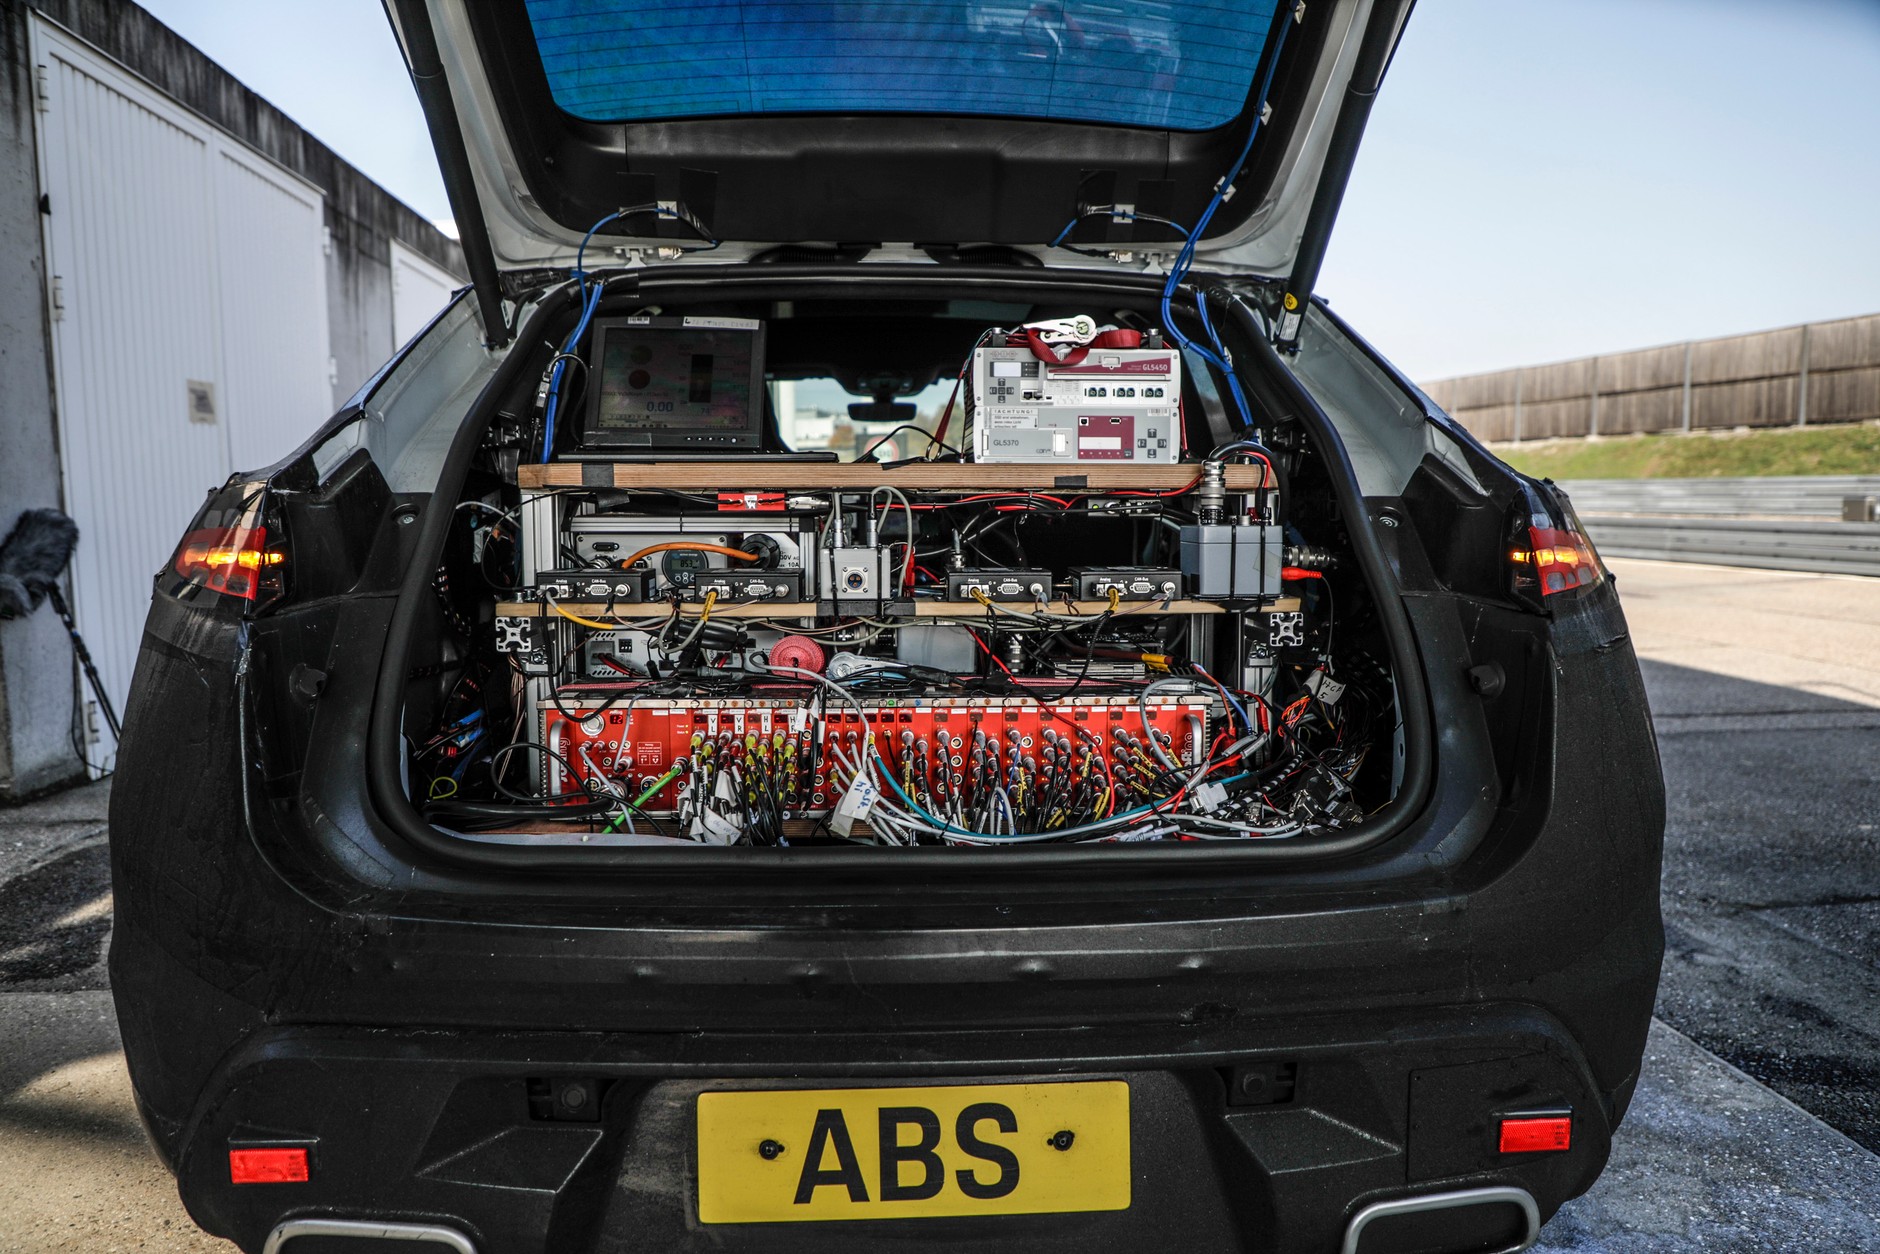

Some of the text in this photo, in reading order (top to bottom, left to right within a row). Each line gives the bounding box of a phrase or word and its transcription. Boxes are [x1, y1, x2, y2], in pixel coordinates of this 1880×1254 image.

[1142, 363, 1168, 371] GL5450
[646, 401, 674, 412] 0.00
[1319, 691, 1329, 701] 5
[793, 1102, 1020, 1204] ABS
